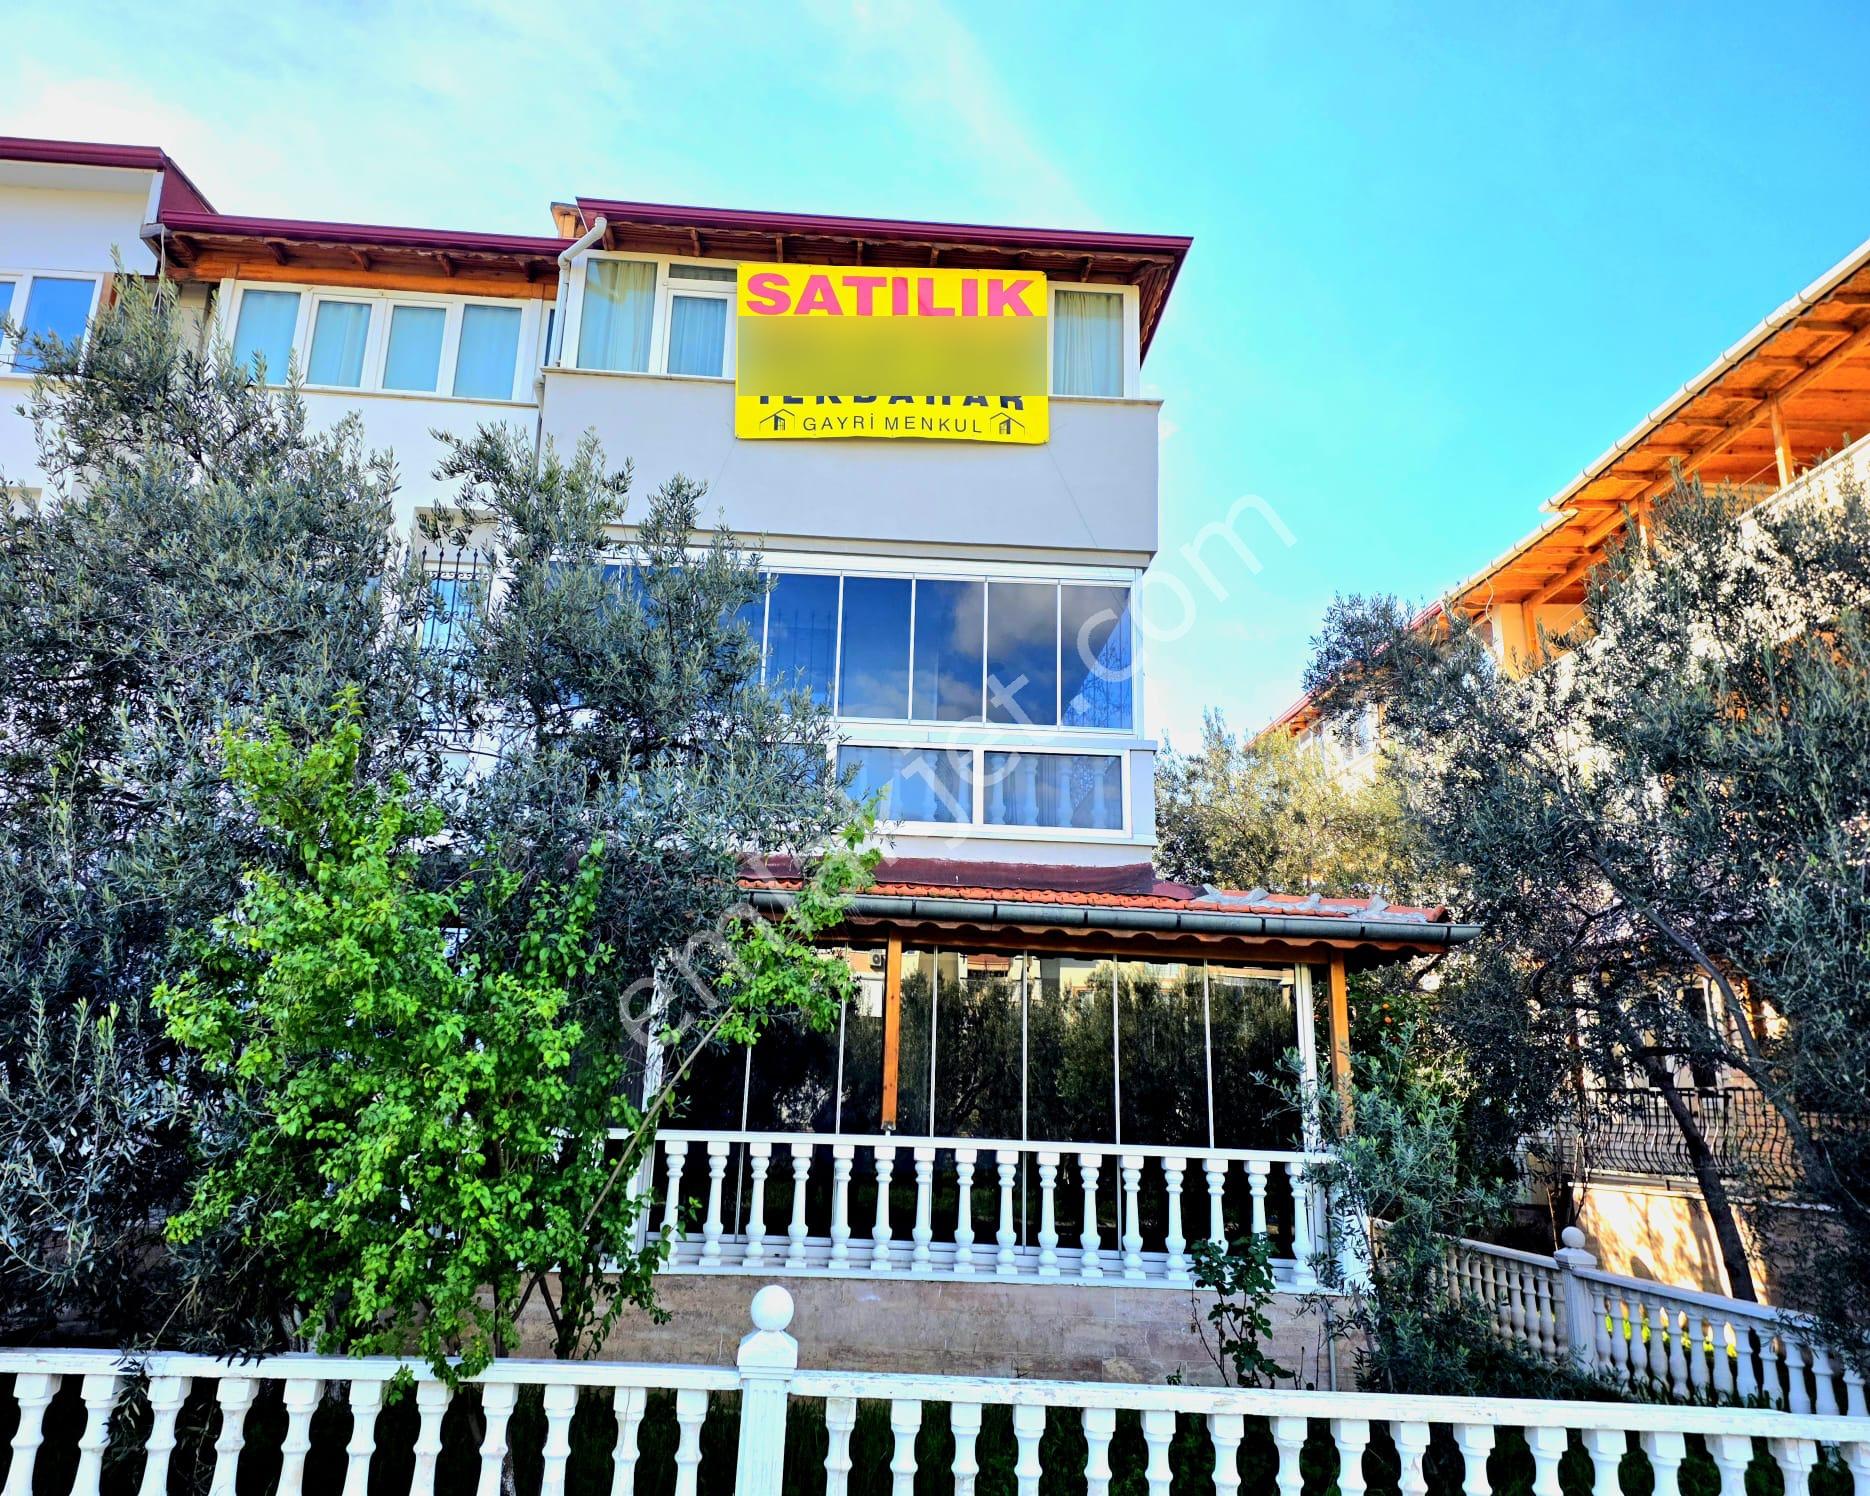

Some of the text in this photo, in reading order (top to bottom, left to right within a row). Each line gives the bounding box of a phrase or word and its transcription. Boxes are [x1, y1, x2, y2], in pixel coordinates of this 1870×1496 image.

[746, 273, 1033, 316] SATILIK
[803, 412, 982, 433] GAYRİ MENKUL
